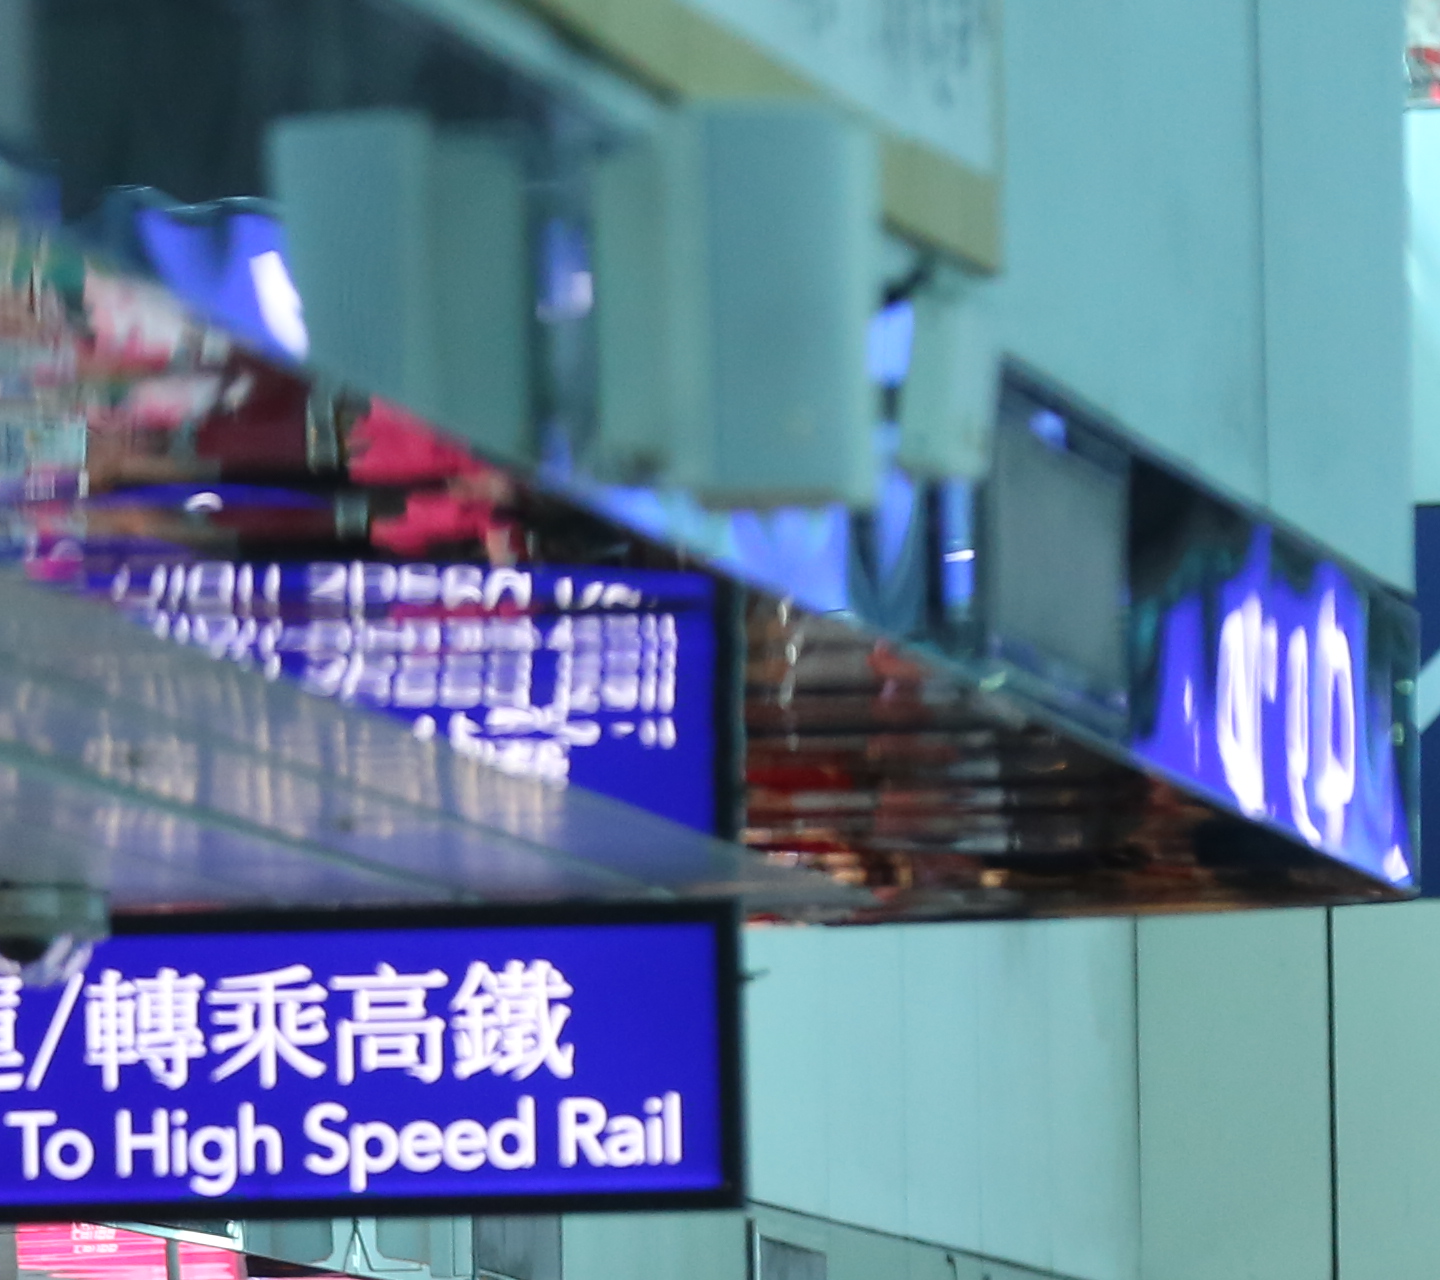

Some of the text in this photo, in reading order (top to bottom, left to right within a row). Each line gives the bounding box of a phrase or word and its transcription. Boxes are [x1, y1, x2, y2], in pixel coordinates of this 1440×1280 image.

[3, 1109, 94, 1180] To
[115, 1101, 283, 1197] High
[303, 1095, 536, 1193] Speed
[558, 1090, 682, 1168] Rail
